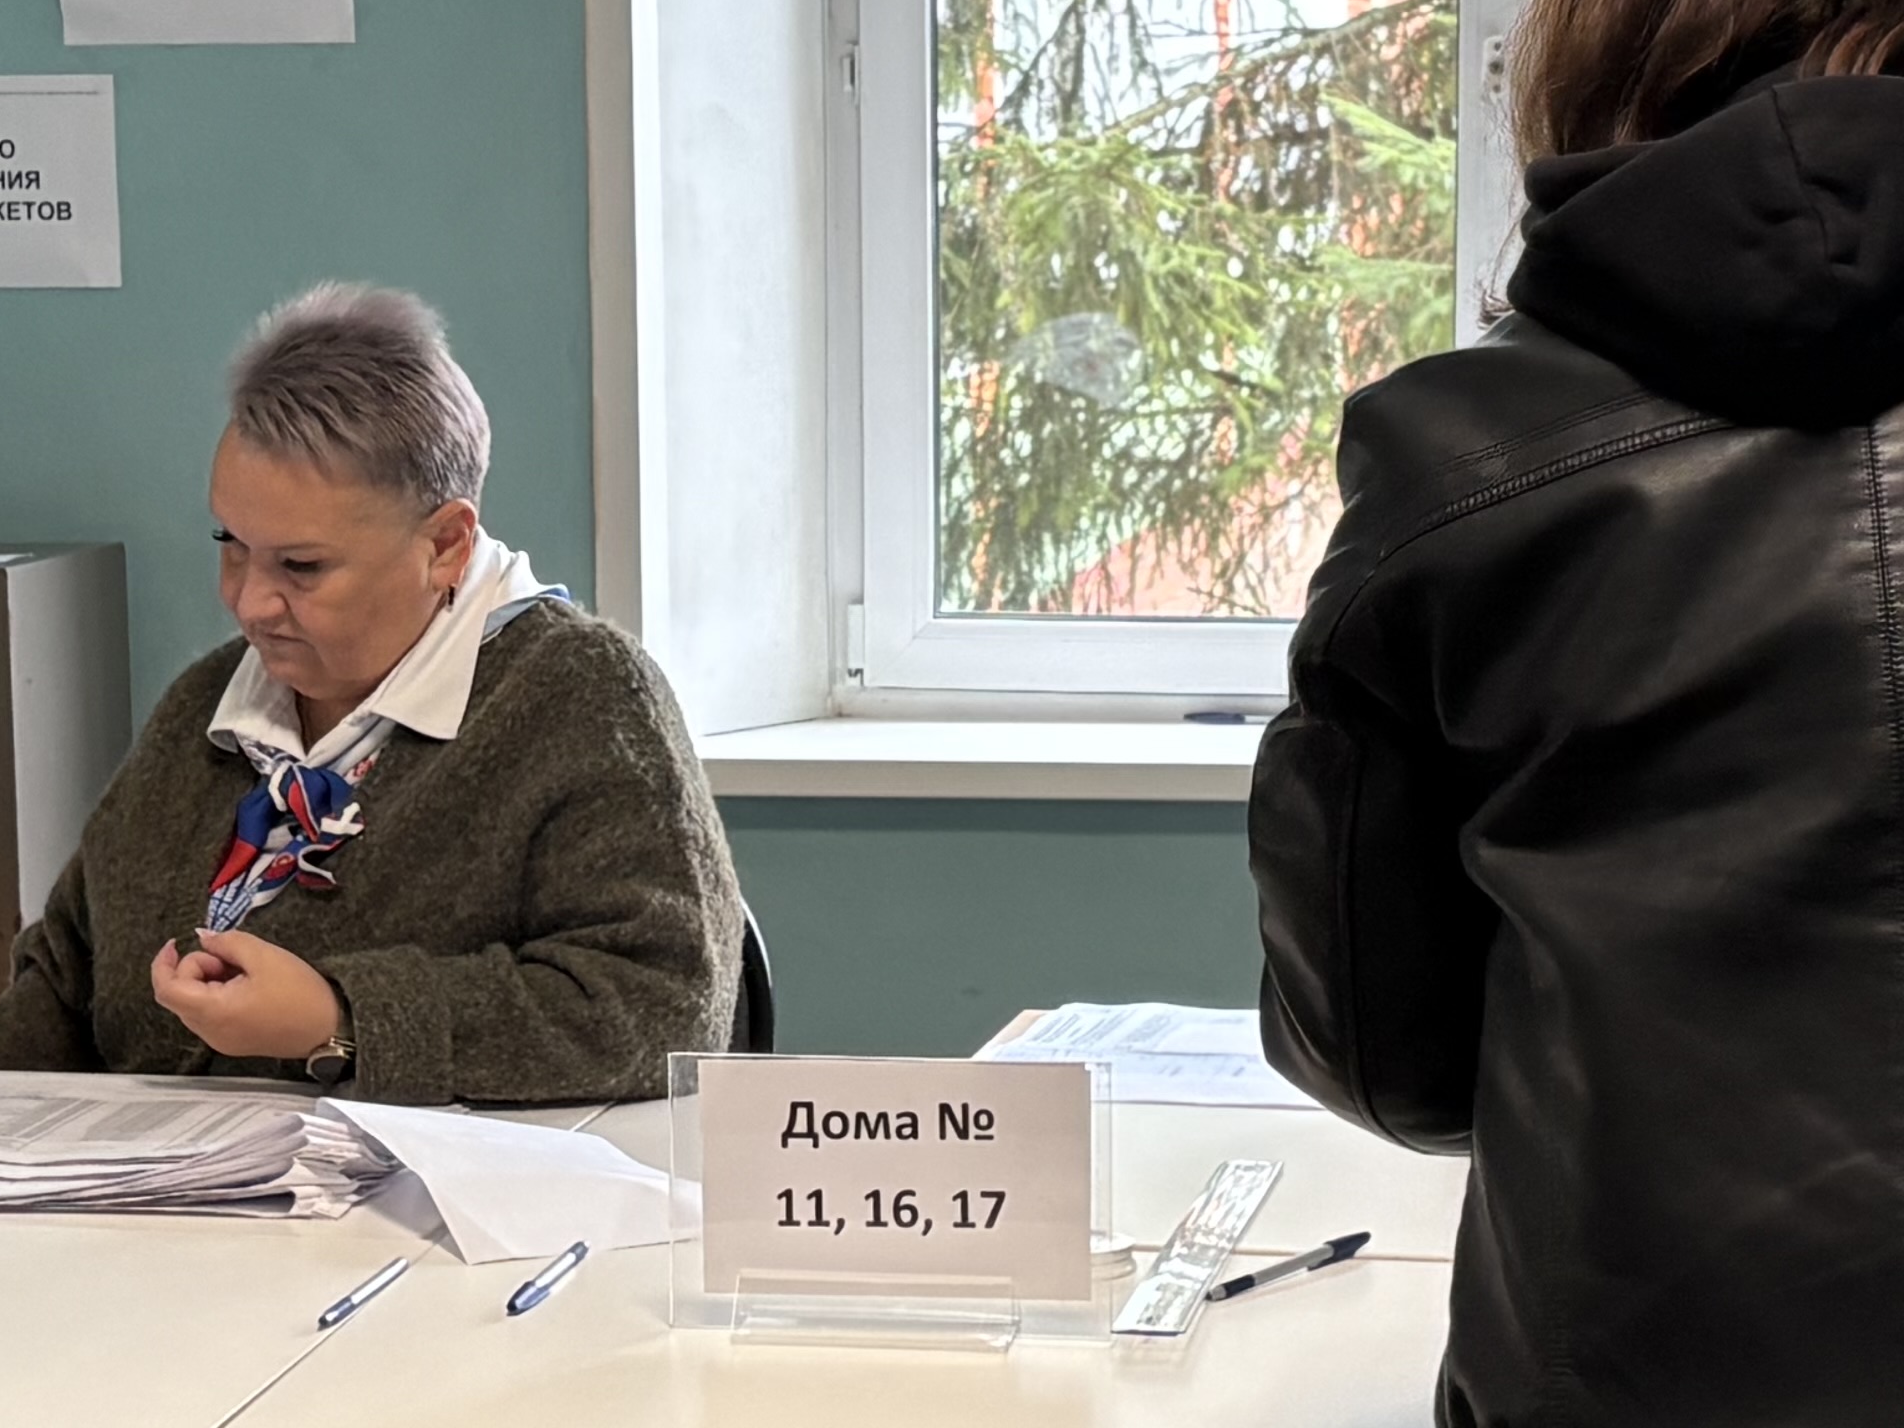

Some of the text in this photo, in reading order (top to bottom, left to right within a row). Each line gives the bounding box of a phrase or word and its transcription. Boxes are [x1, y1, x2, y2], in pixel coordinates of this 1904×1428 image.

[780, 1100, 996, 1149] Дома №
[776, 1188, 1007, 1236] 11, 16, 17
